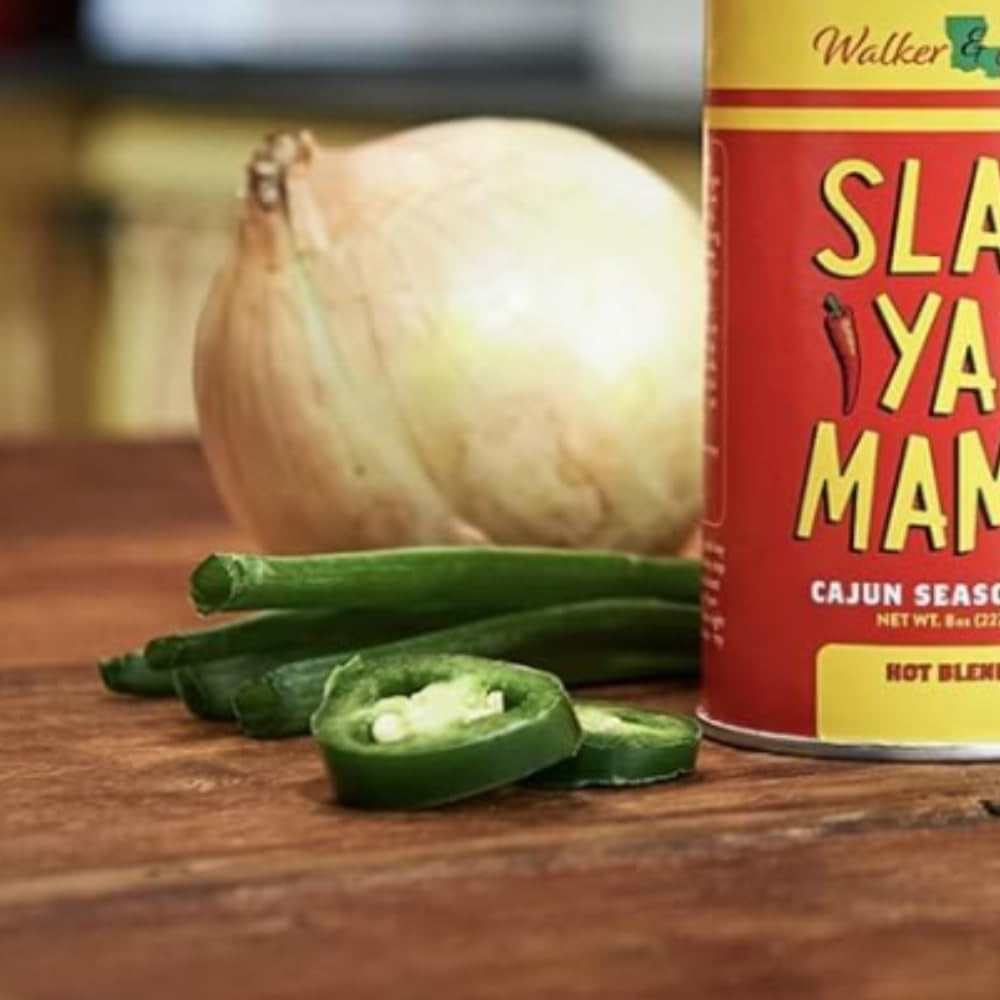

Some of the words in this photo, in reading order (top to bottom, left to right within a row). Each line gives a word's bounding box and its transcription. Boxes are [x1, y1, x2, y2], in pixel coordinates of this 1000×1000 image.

[812, 24, 949, 66] Walker
[960, 26, 985, 60] &
[873, 291, 996, 416] YA
[811, 579, 902, 606] CAJUN
[876, 612, 910, 628] NET
[913, 612, 942, 628] WT.
[886, 662, 932, 683] HOT
